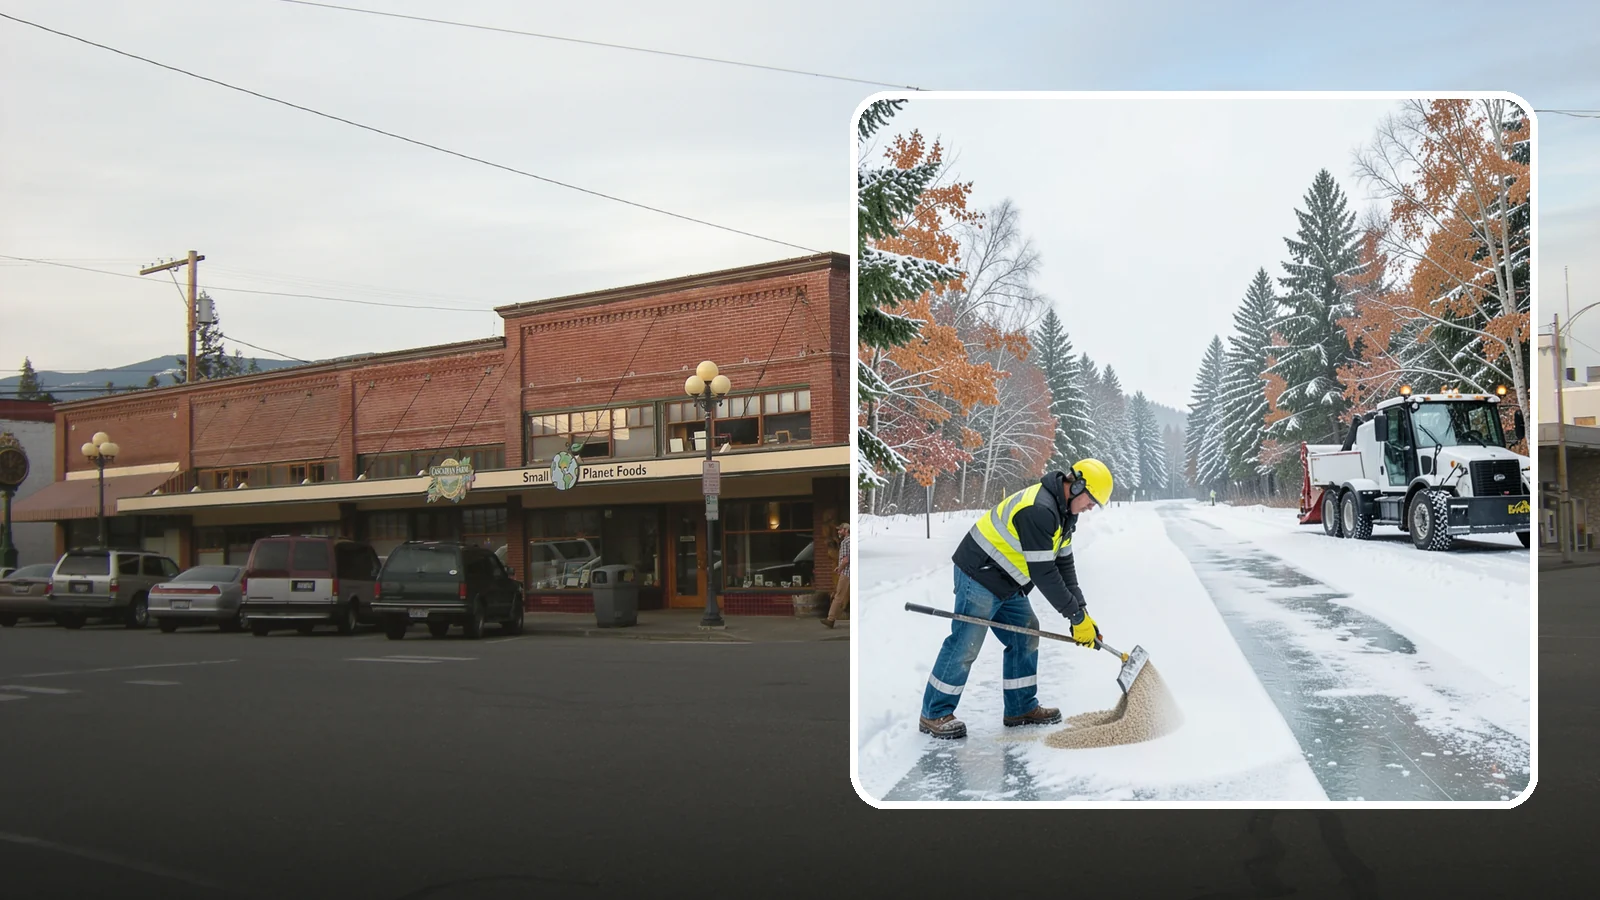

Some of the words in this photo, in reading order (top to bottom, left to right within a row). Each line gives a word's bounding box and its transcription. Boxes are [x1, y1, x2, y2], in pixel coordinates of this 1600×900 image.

[523, 471, 549, 483] Small
[583, 467, 614, 479] Planet
[617, 464, 647, 477] Foods
